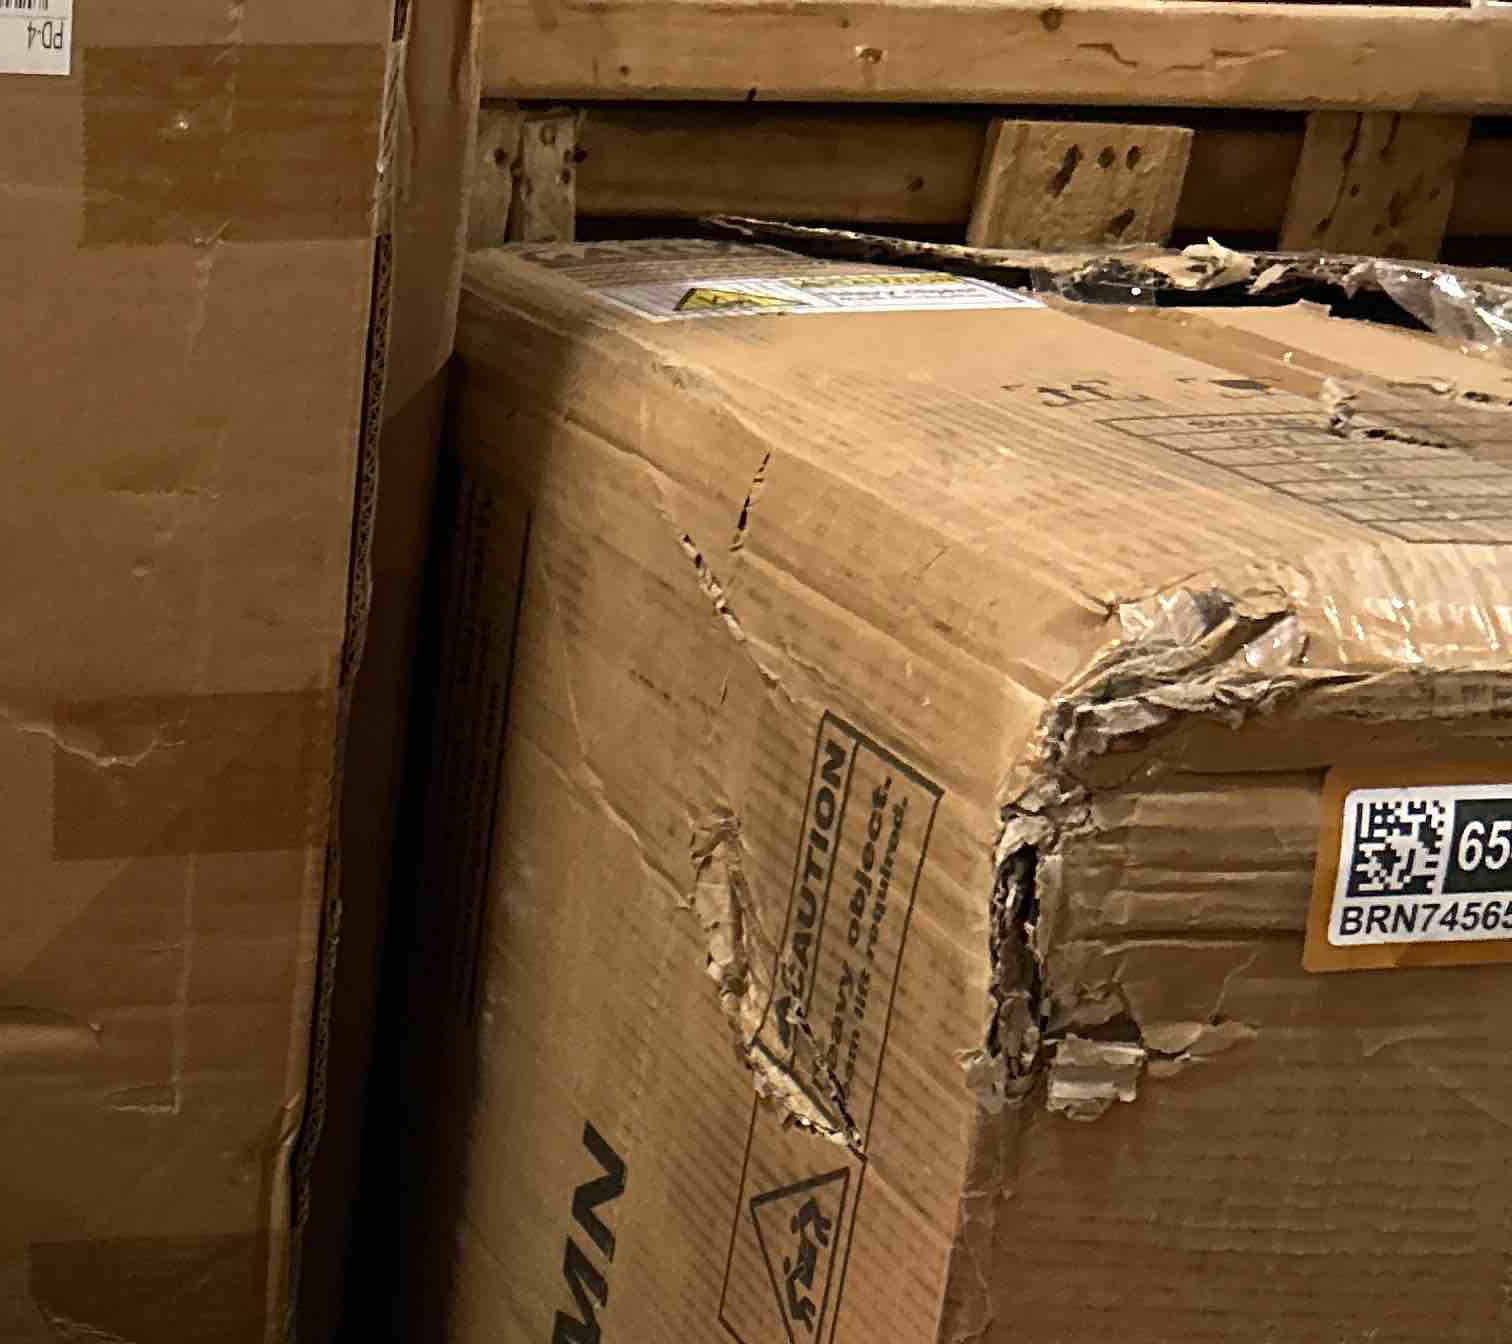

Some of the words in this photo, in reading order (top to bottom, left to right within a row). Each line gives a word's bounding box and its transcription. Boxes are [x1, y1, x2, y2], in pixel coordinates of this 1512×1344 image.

[27, 21, 65, 50] PD-4
[781, 735, 848, 1000] CAUTION
[847, 775, 893, 947] object.
[864, 795, 908, 961] required.
